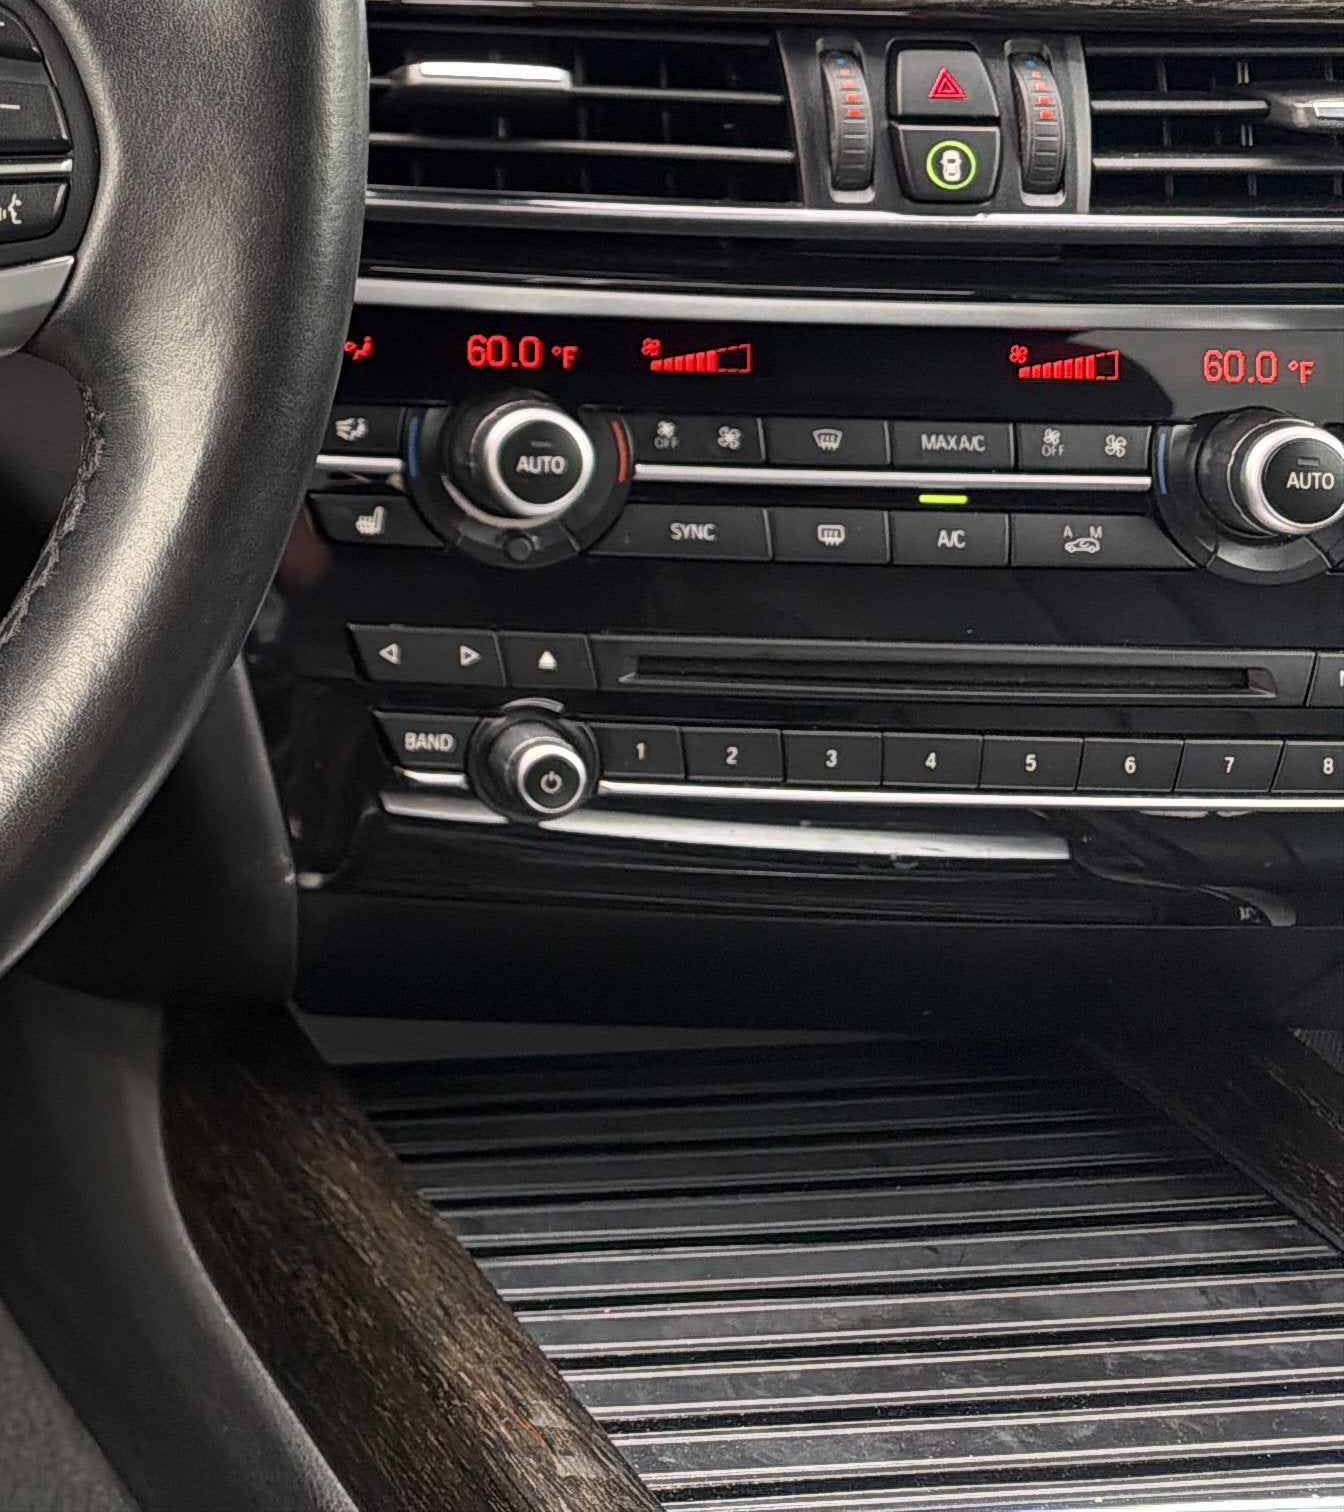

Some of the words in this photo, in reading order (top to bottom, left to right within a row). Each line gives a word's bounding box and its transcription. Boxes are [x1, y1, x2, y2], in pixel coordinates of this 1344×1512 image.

[467, 334, 543, 370] 60.0
[1203, 349, 1278, 384] 60.0
[1041, 443, 1065, 457] OFF
[516, 455, 566, 475] AUTO
[1286, 471, 1335, 490] AUTO
[670, 522, 716, 541] SYNC
[937, 529, 966, 549] A/C
[1063, 525, 1074, 539] A
[1089, 525, 1103, 539] M
[404, 732, 454, 752] BAND
[635, 742, 645, 760] 1
[725, 746, 738, 765] 2
[825, 749, 838, 768] 3
[924, 752, 937, 769] 4
[1025, 754, 1037, 772] 5
[1124, 756, 1137, 774] 6
[1224, 756, 1235, 774] 7
[1322, 758, 1334, 775] 8
